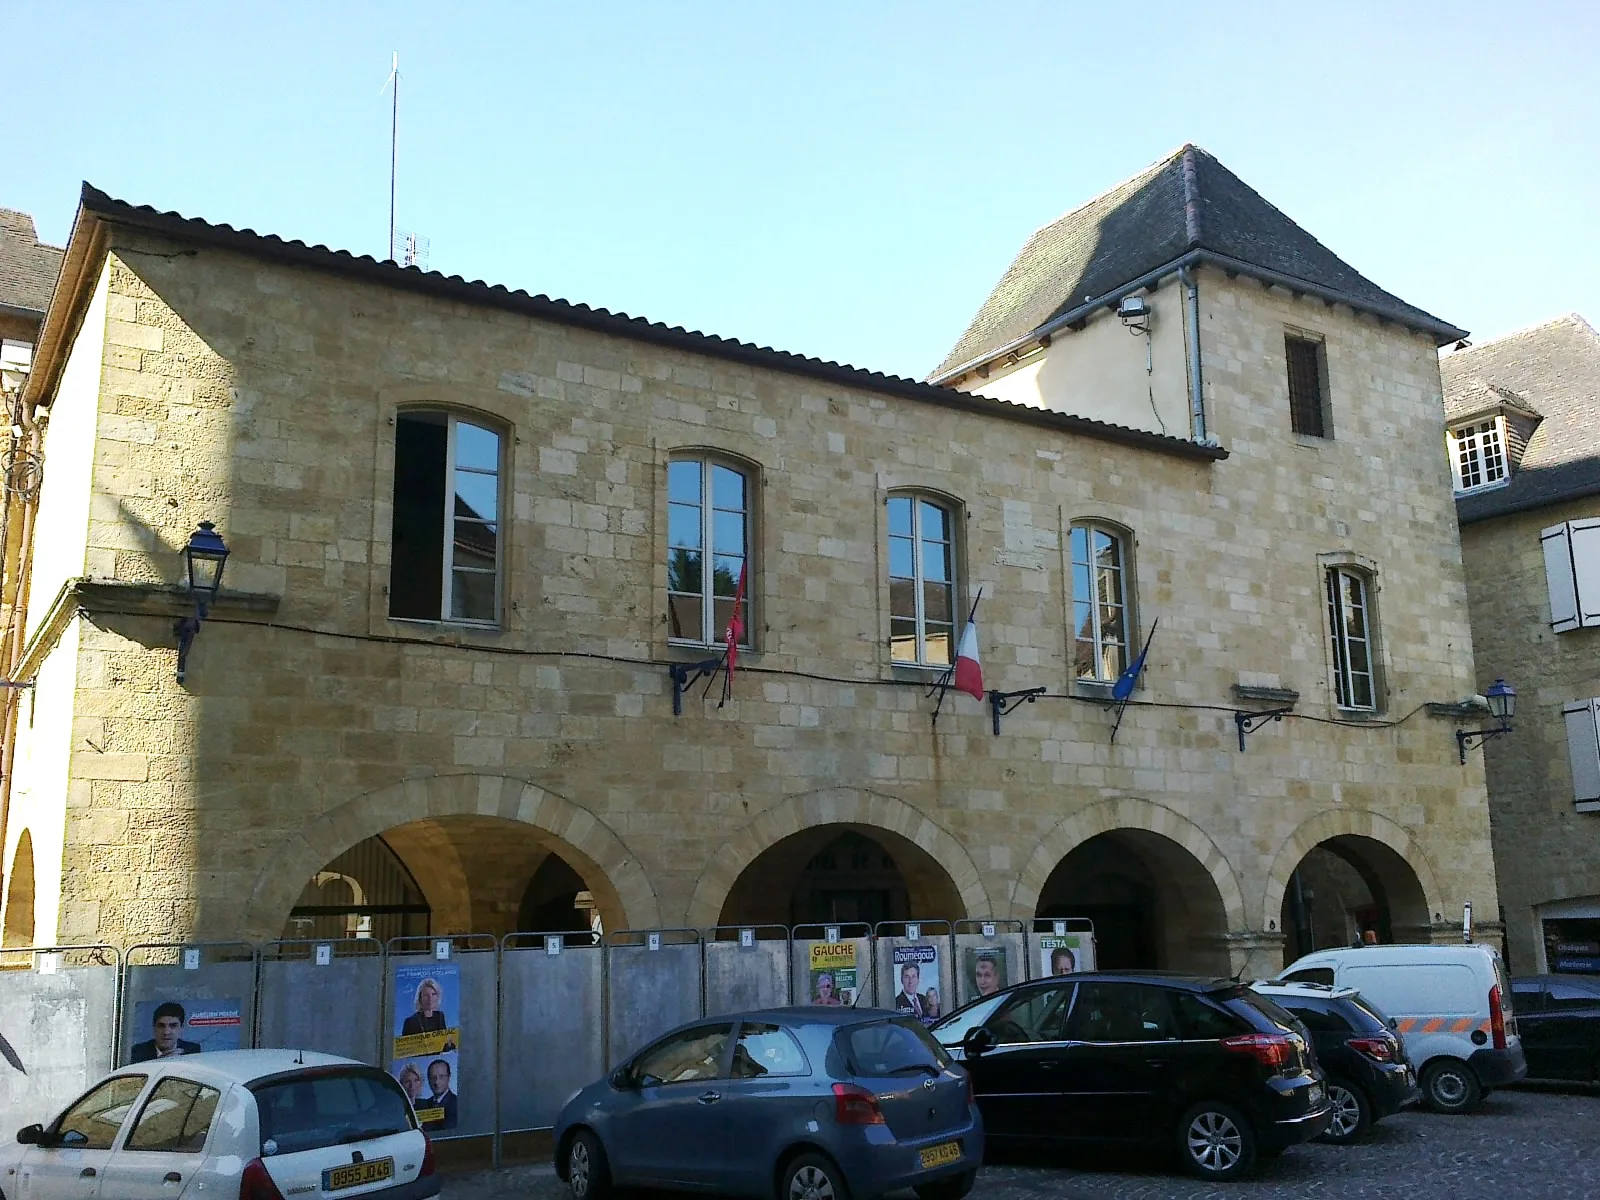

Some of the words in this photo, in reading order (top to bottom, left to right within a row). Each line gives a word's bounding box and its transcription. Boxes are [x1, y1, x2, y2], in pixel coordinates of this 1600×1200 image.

[813, 944, 853, 956] GAUCHE
[1041, 940, 1067, 948] TESTA
[333, 1167, 361, 1186] 8955
